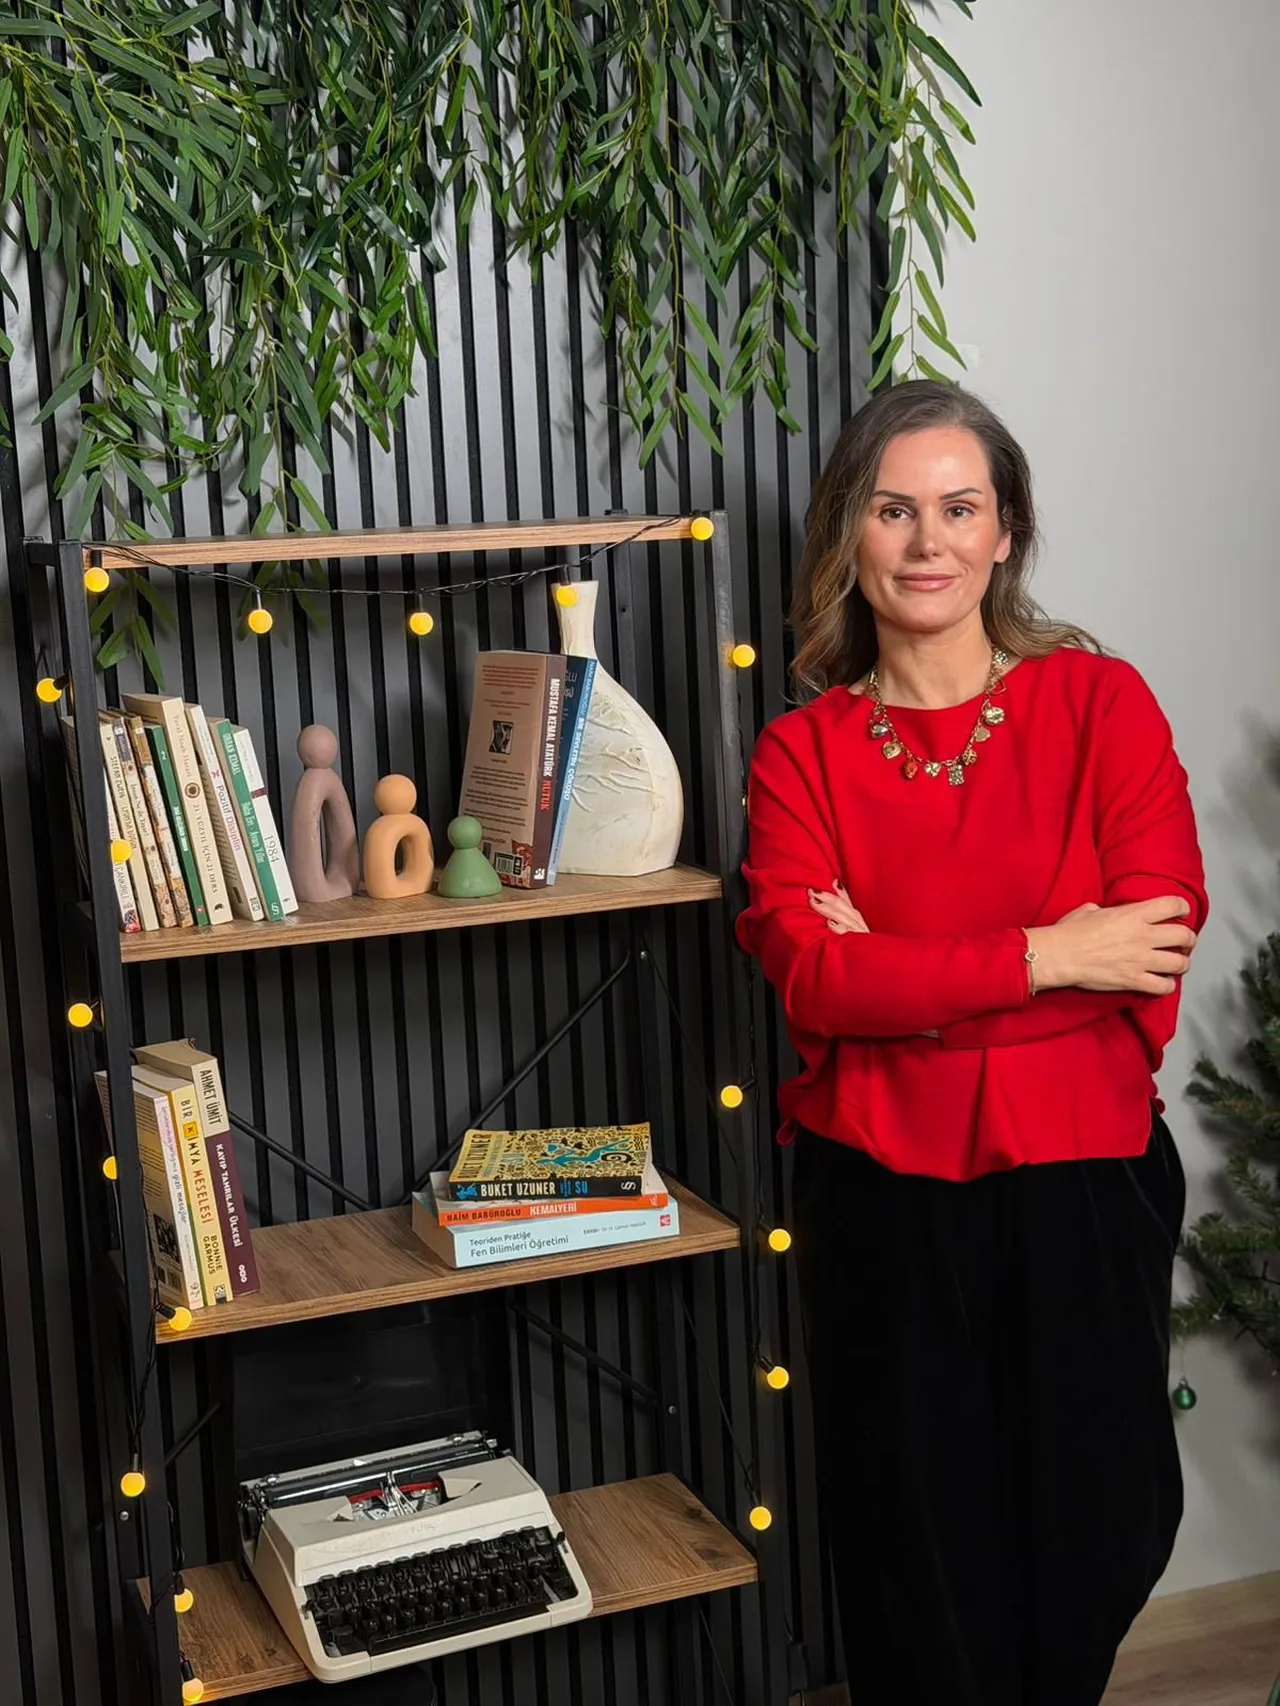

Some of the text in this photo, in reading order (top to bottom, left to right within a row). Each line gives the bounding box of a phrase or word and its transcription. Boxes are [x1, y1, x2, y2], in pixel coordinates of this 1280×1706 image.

[543, 678, 561, 777] MUSTAFA KEMAL ATATÜRK
[540, 779, 552, 812] NUTUK
[216, 784, 232, 818] Pozitif
[226, 817, 241, 852] Disiplin
[264, 834, 280, 863] 1984
[209, 874, 219, 893] DERS
[200, 1069, 222, 1125] AHMET ÜMİT
[181, 1099, 193, 1119] BİR
[193, 1169, 214, 1224] MESELESİ
[172, 1174, 182, 1189] gizli
[177, 1192, 188, 1223] mesajlar
[216, 1143, 244, 1247] KAYIP TANRILAR ÜLKESİ
[480, 1183, 513, 1197] BUKET
[516, 1181, 556, 1196] UZUNER
[574, 1180, 589, 1194] SU
[446, 1208, 521, 1222] NAİM BABÜROĞLU
[529, 1201, 577, 1215] KEMALYERİ
[210, 1234, 223, 1271] BONNIE
[469, 1230, 531, 1246] Teoriden Pratiğe
[471, 1234, 569, 1258] Fen Bilimleri Öğretimi
[203, 1235, 216, 1275] GARMUS
